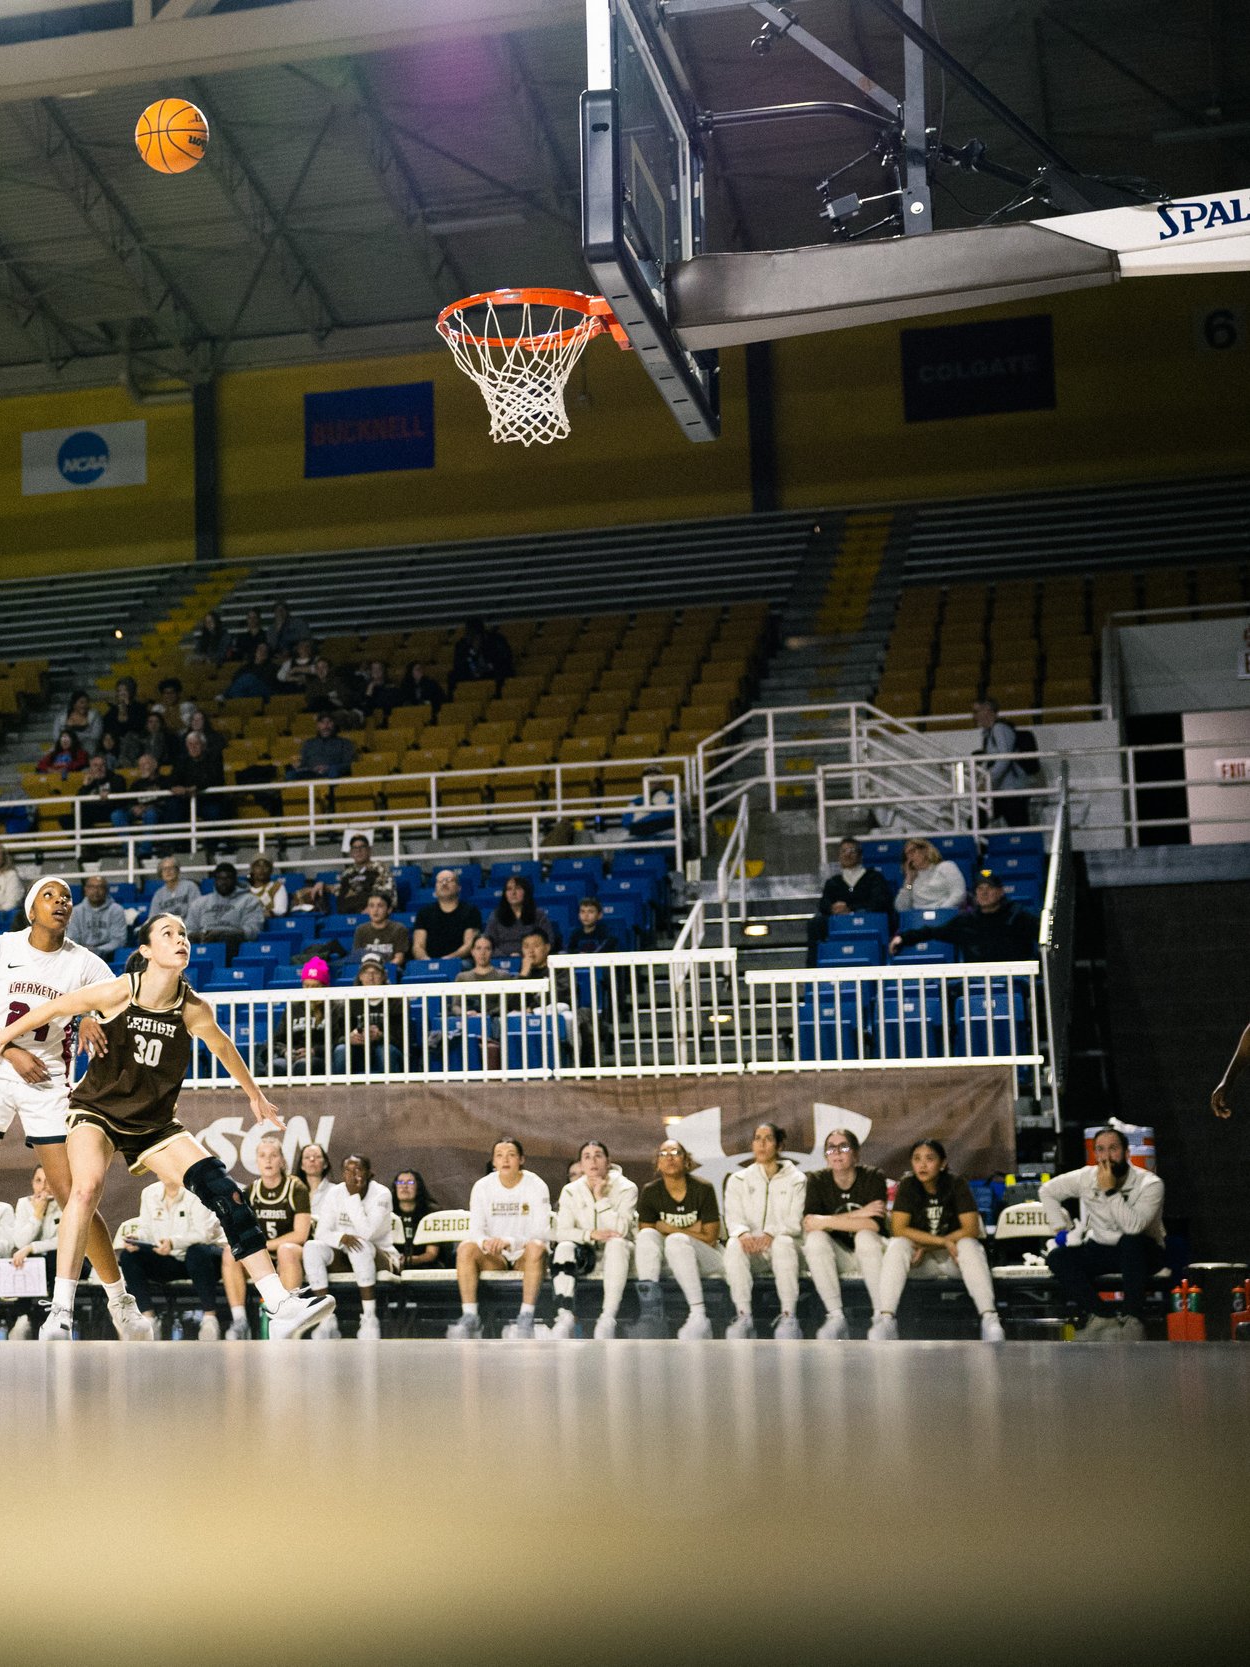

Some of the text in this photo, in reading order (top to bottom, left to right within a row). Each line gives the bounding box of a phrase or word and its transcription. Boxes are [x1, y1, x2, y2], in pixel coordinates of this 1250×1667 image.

[1203, 309, 1236, 349] 6
[918, 354, 1038, 384] COLGATE
[61, 455, 109, 474] NCAA
[8, 981, 64, 1000] LAFAYETT
[125, 1015, 177, 1038] LEHIGH
[133, 1034, 163, 1067] 30
[265, 1221, 278, 1239] 5
